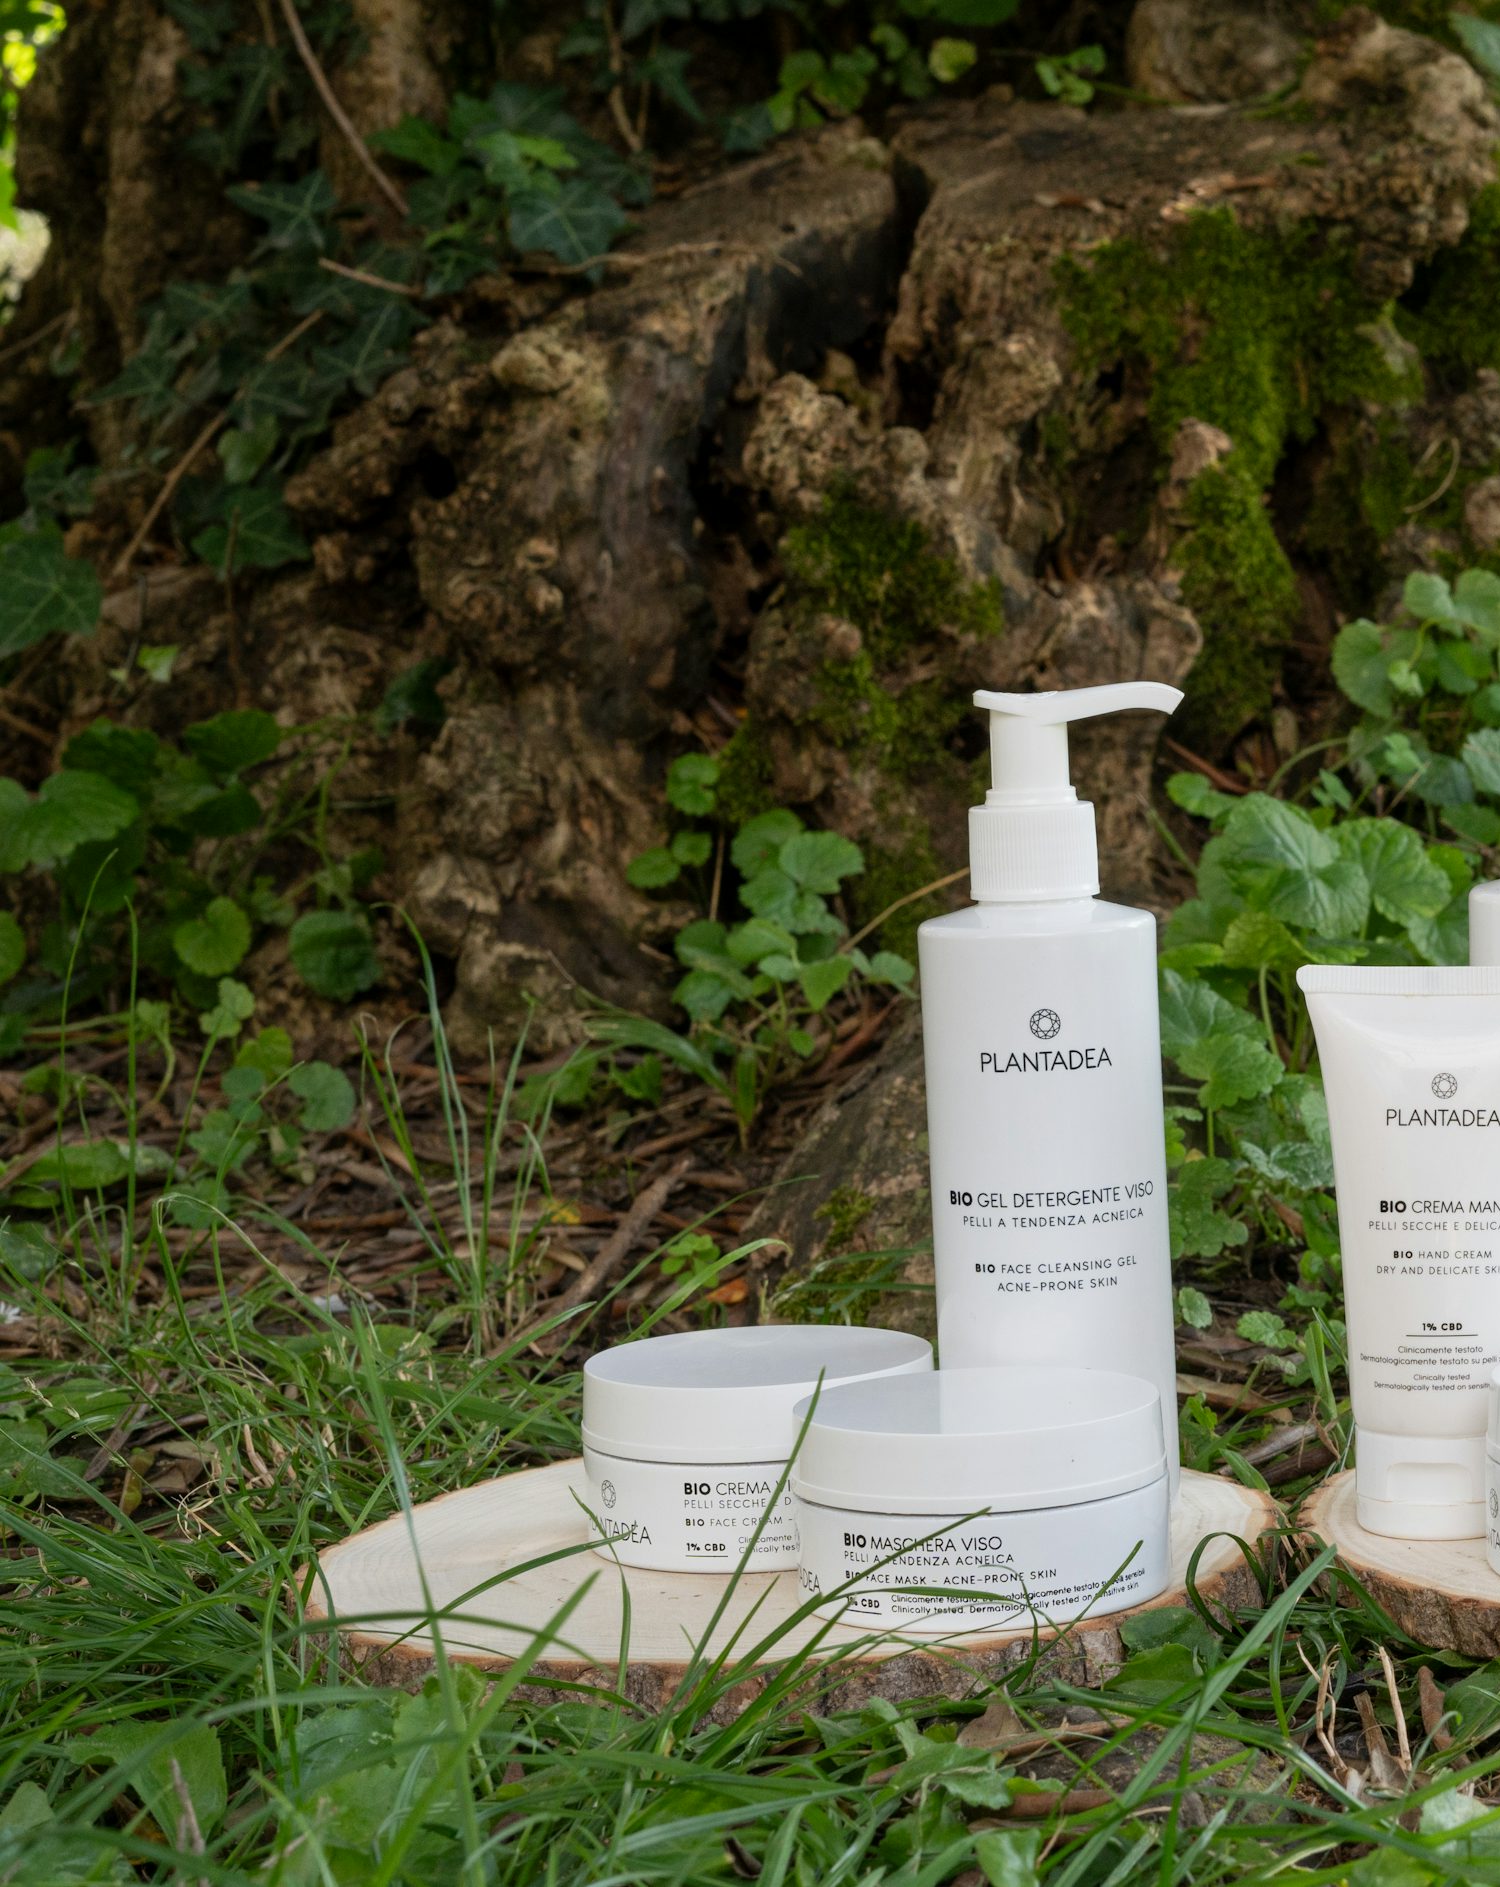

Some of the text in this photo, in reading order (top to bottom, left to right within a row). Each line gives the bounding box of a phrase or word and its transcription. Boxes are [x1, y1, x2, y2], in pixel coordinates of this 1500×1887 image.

[980, 1047, 1112, 1072] PLANTADEA
[950, 1180, 1154, 1208] BIO GEL DETERGENTE VISO
[1380, 1201, 1406, 1213] BIO
[1412, 1200, 1464, 1214] CREMA
[963, 1208, 1144, 1228] PELLI A TENDENZA ACNEICA
[1369, 1221, 1397, 1231] PELLI
[1402, 1221, 1448, 1231] SECCHE
[1454, 1221, 1459, 1230] E
[1393, 1250, 1492, 1259] BIO HAND CREAM
[975, 1255, 1137, 1274] BIO FACE CLEANSING GEL
[1376, 1266, 1396, 1275] DRY
[1401, 1266, 1423, 1275] AND
[1429, 1266, 1479, 1275] DELICATE
[998, 1276, 1118, 1292] ACNE-PRONE SKIN
[1422, 1323, 1463, 1331] 1% CBD
[1398, 1346, 1452, 1354] Clinicamente
[1360, 1353, 1437, 1366] Dermatologicamente
[1440, 1357, 1469, 1365] testato
[684, 1483, 711, 1495] BIO
[716, 1482, 771, 1495] CREMA
[684, 1499, 766, 1509] PELLI SECCHE
[686, 1519, 737, 1527] BIO FACE
[687, 1542, 726, 1551] 1% CBD
[844, 1533, 866, 1548] BIO
[961, 1536, 1002, 1551] VISO
[844, 1551, 1014, 1566] PELLI ACNEICA
[895, 1569, 1057, 1585] MASK ACNE-PRONE SKIN
[861, 1599, 880, 1608] CBD
[891, 1595, 944, 1603] Clinicamente
[891, 1606, 930, 1615] Clinically
[1052, 1596, 1079, 1607] tested
